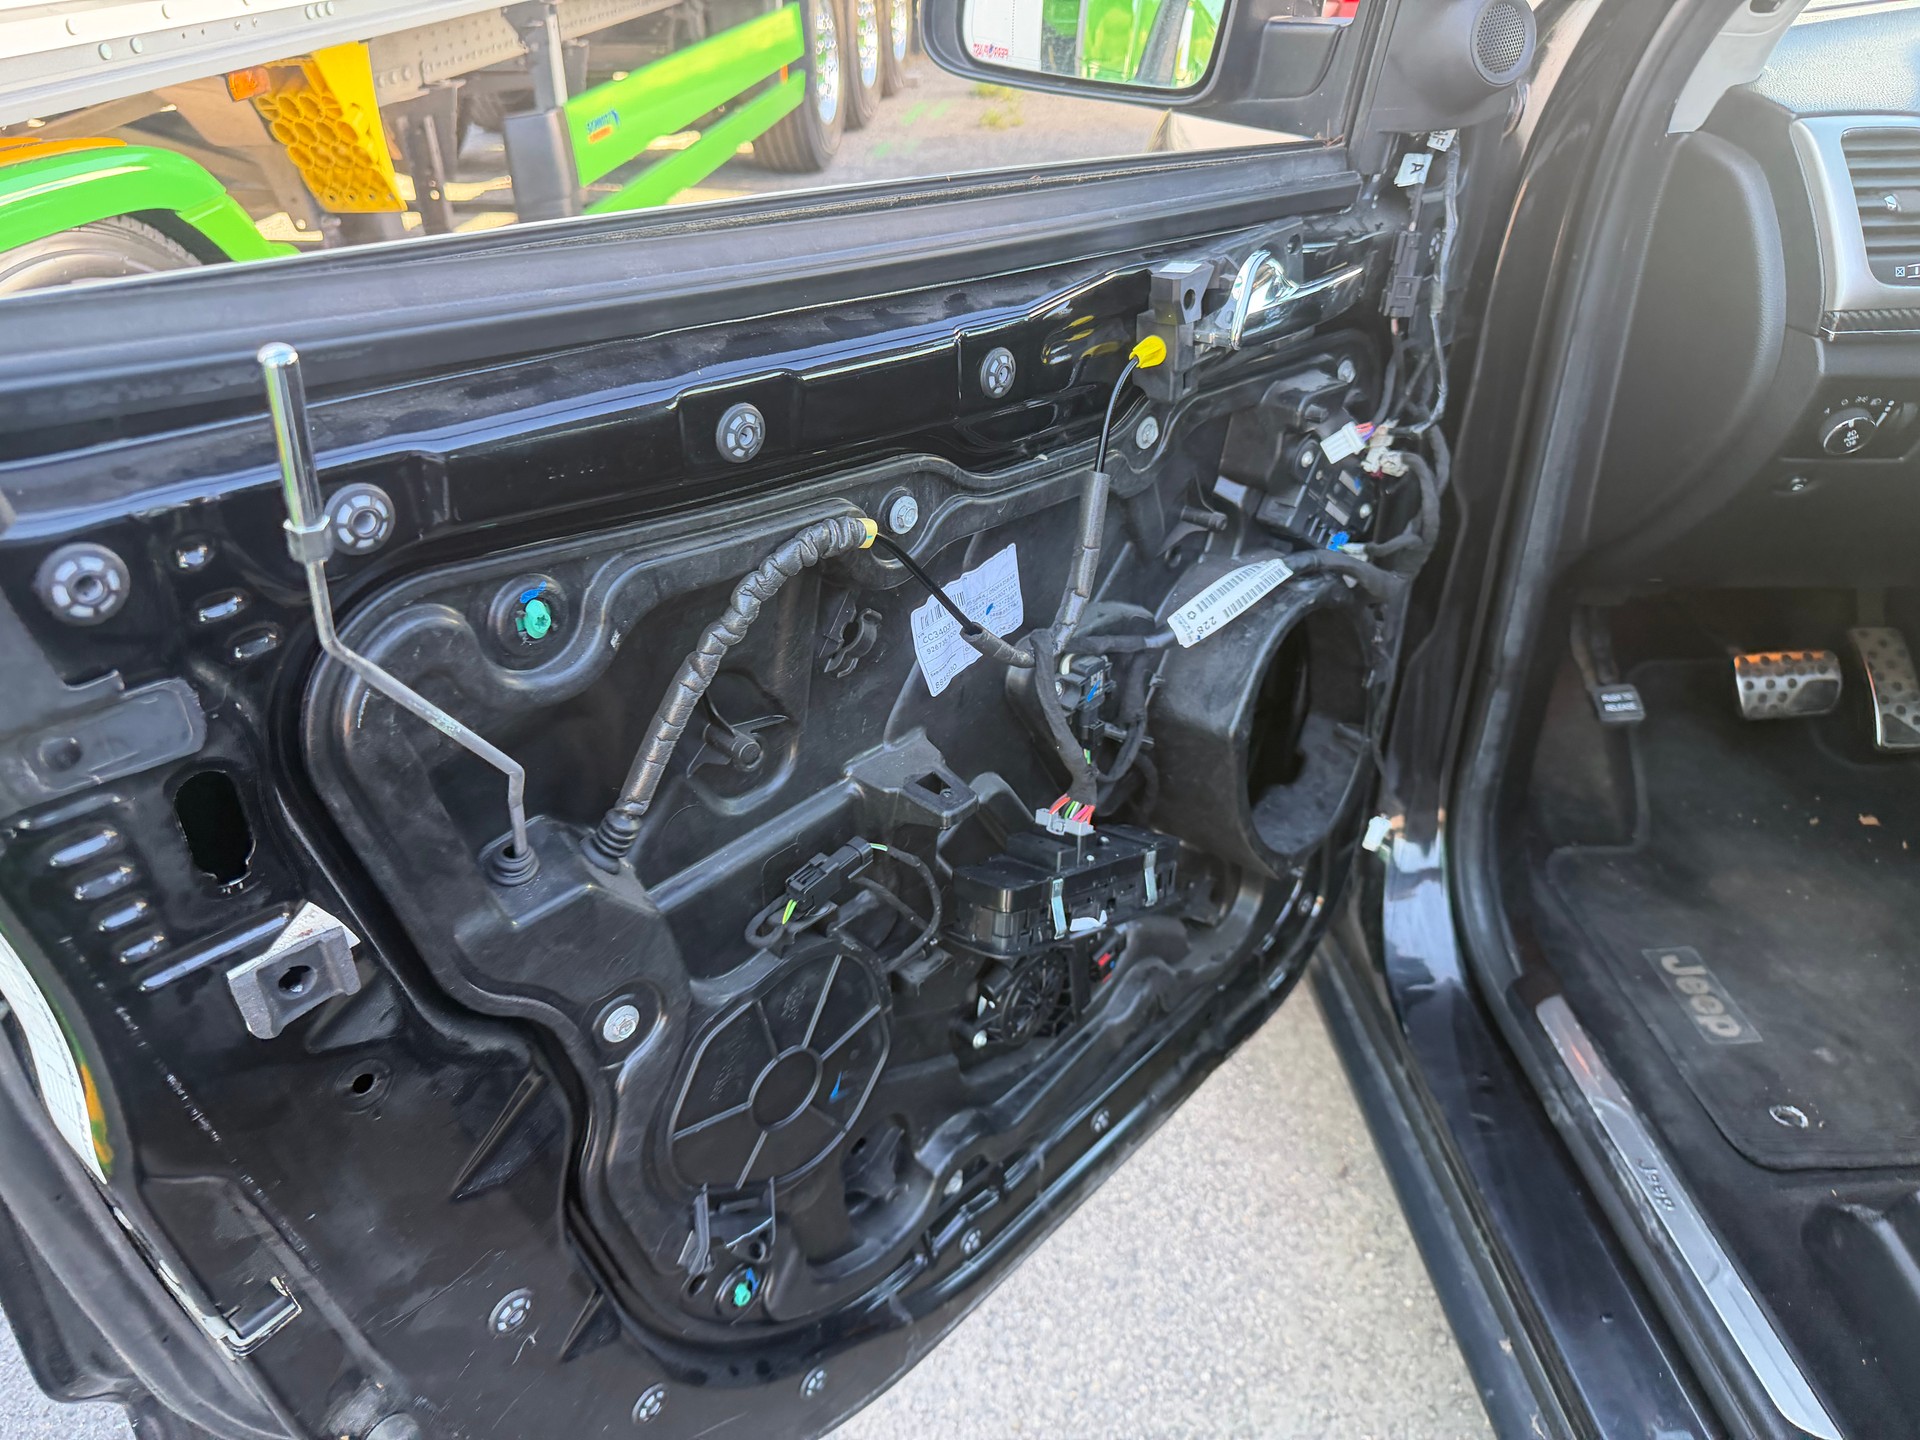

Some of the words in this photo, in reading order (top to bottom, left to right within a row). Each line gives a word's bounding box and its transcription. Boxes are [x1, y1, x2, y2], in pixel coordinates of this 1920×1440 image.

[1409, 162, 1425, 175] A
[1197, 616, 1218, 635] 228
[1660, 954, 1741, 1038] Jeep
[1638, 1158, 1677, 1211] Jeep
